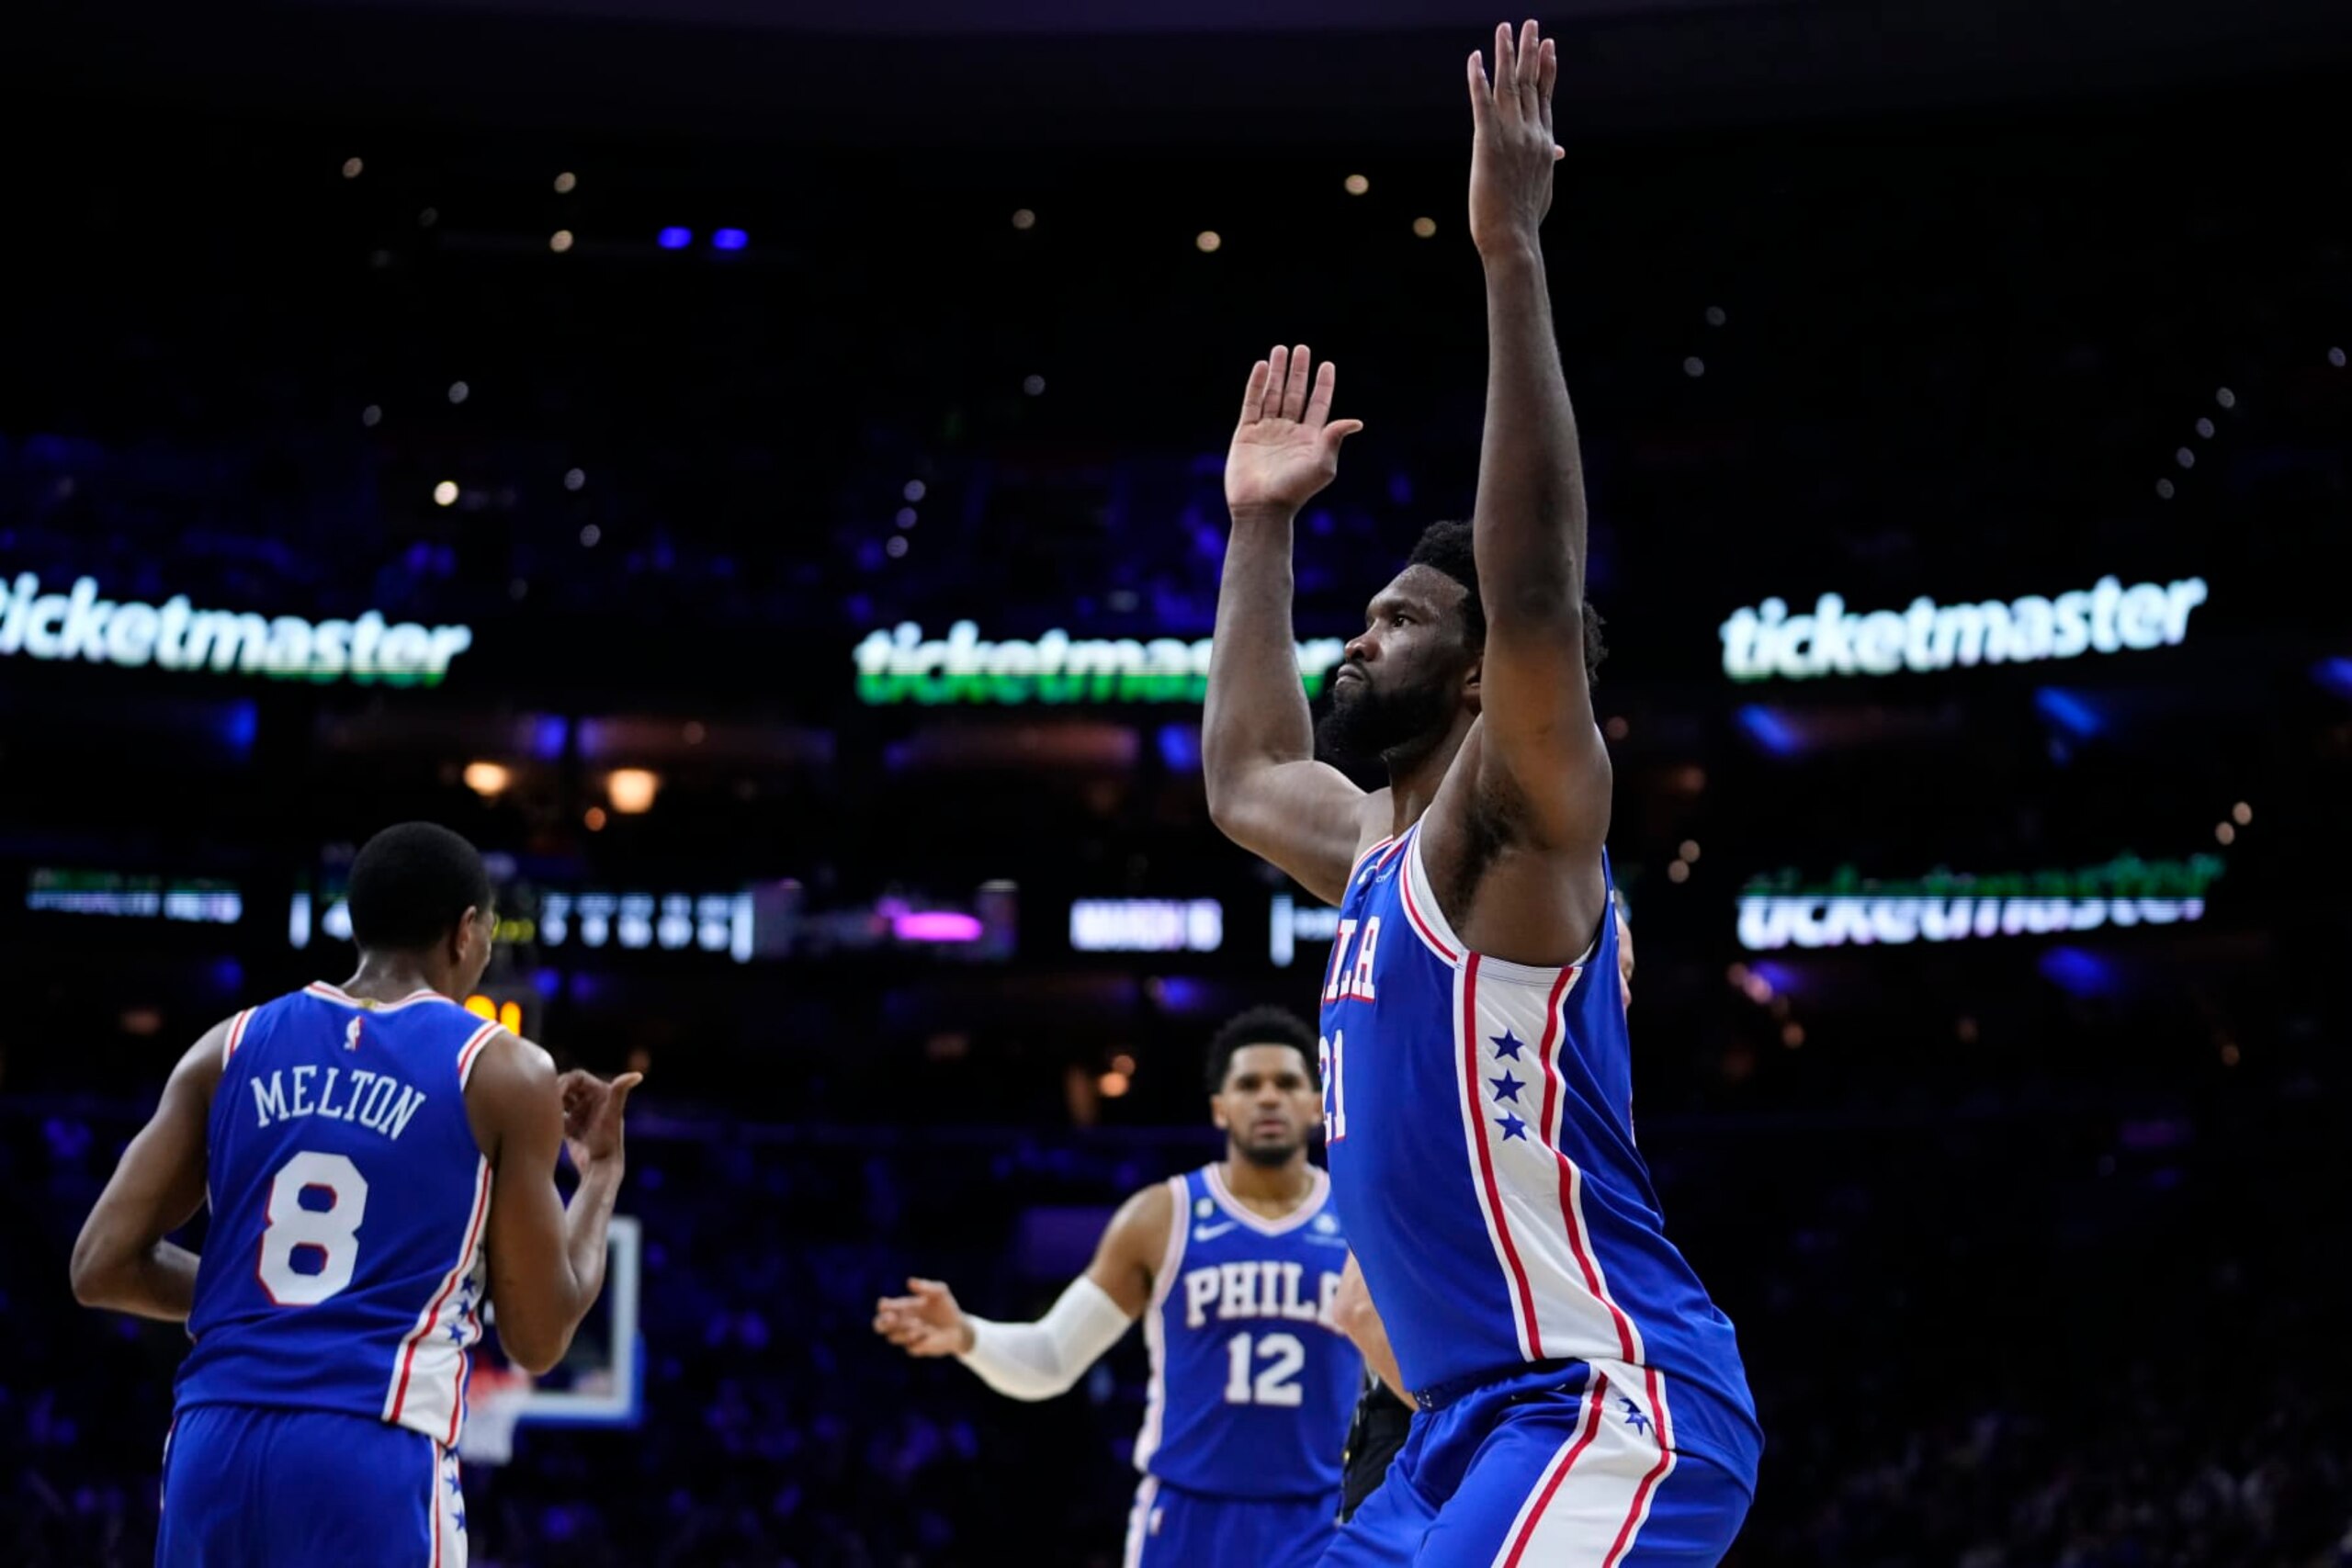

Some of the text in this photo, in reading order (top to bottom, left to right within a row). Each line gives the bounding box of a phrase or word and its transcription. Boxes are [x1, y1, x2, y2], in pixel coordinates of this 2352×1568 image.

[0, 571, 473, 689] icketmaster
[854, 620, 1345, 704] ticketmar
[1717, 574, 2208, 683] ticketmaster
[250, 1065, 427, 1140] MELTON
[255, 1150, 368, 1306] 8
[1225, 1331, 1306, 1408] 12
